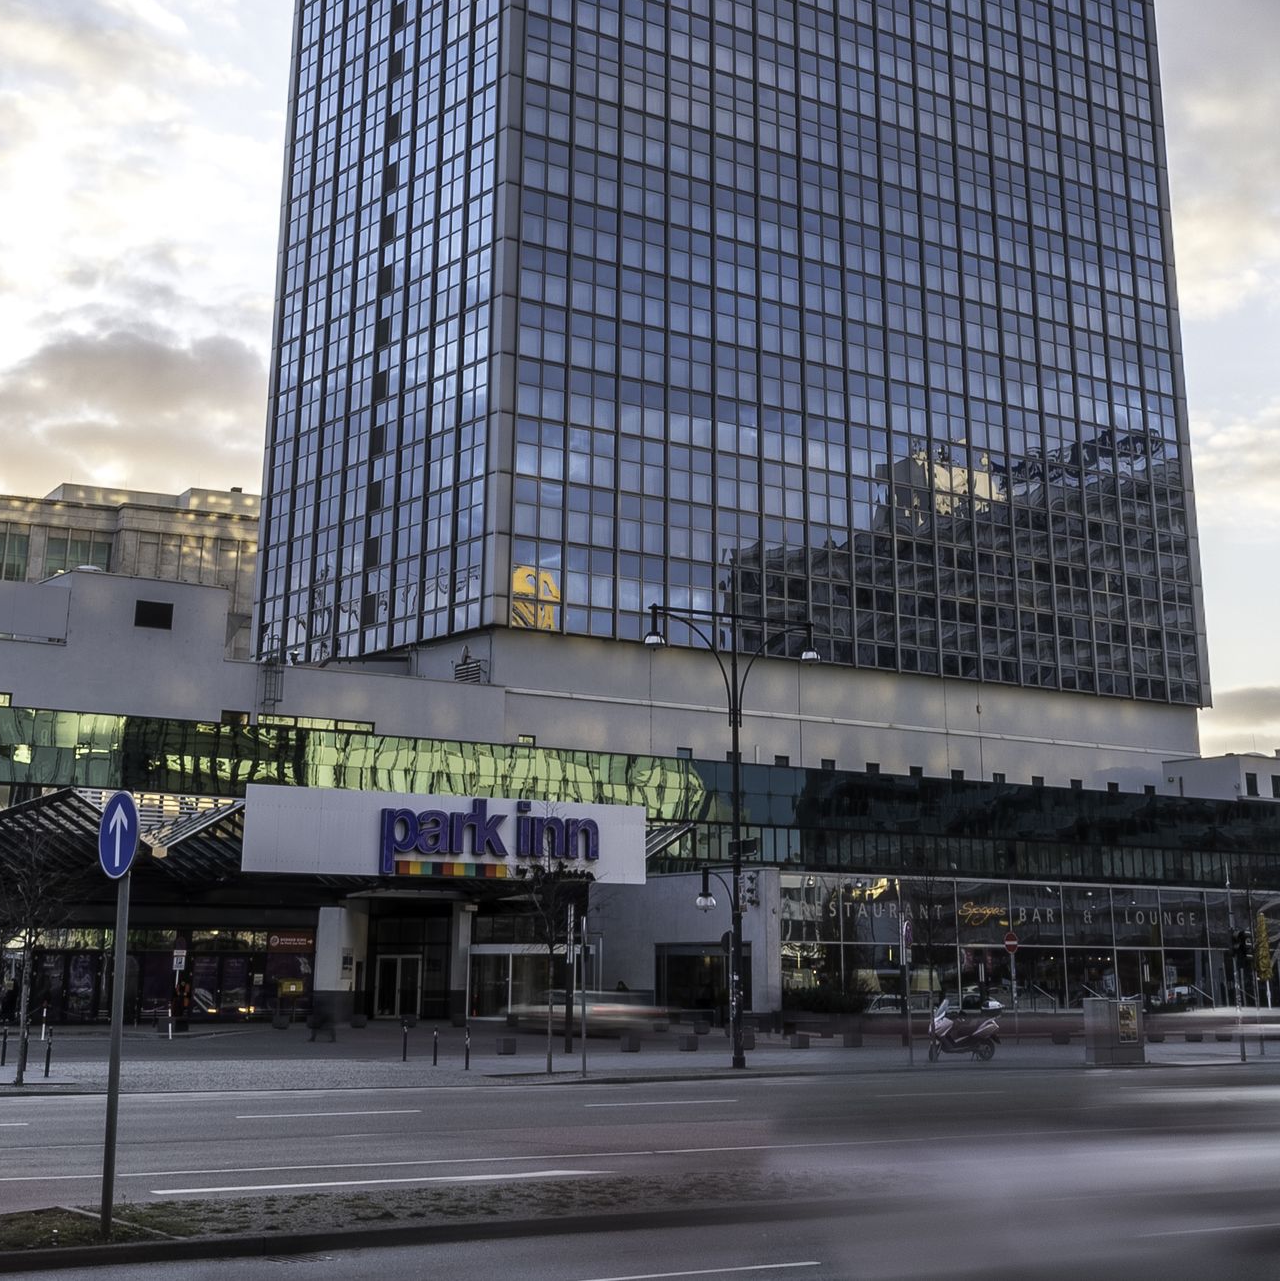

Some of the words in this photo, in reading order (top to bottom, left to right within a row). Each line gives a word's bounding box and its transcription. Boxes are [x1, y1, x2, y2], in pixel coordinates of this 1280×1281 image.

[379, 798, 508, 875] park
[516, 800, 600, 860] inn
[801, 900, 944, 921] RESTAURANT
[1019, 906, 1055, 923] BAR
[1124, 909, 1197, 927] LOUNGE
